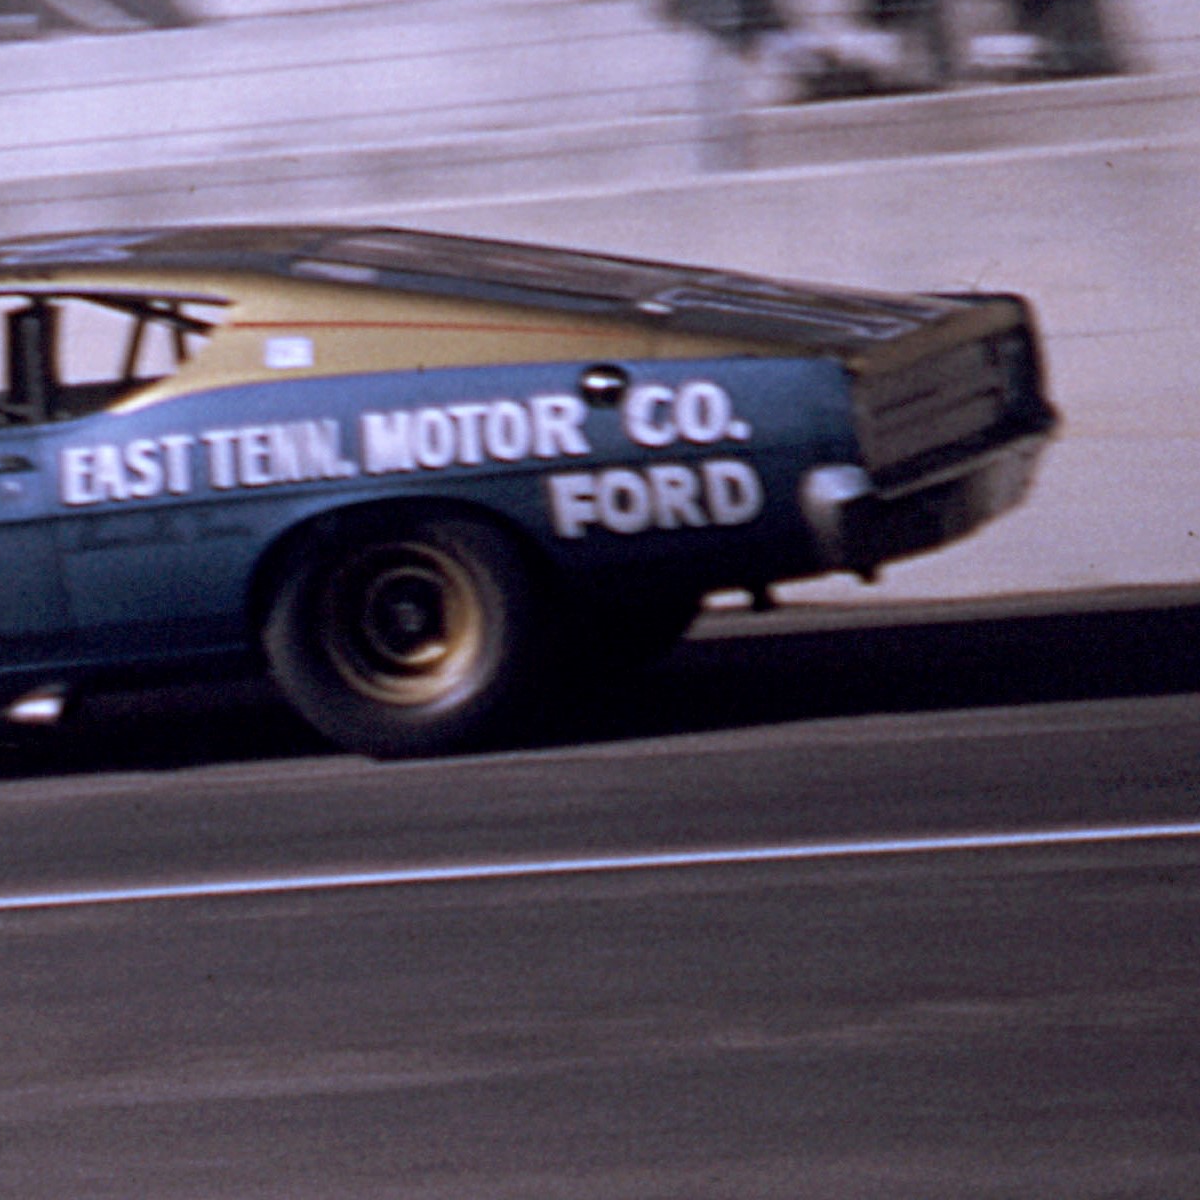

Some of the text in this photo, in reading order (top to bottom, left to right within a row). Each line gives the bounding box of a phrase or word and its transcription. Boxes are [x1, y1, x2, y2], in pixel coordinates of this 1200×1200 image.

[61, 381, 752, 505] EAST TENN. MOTOR CO.
[548, 459, 763, 540] FORD
